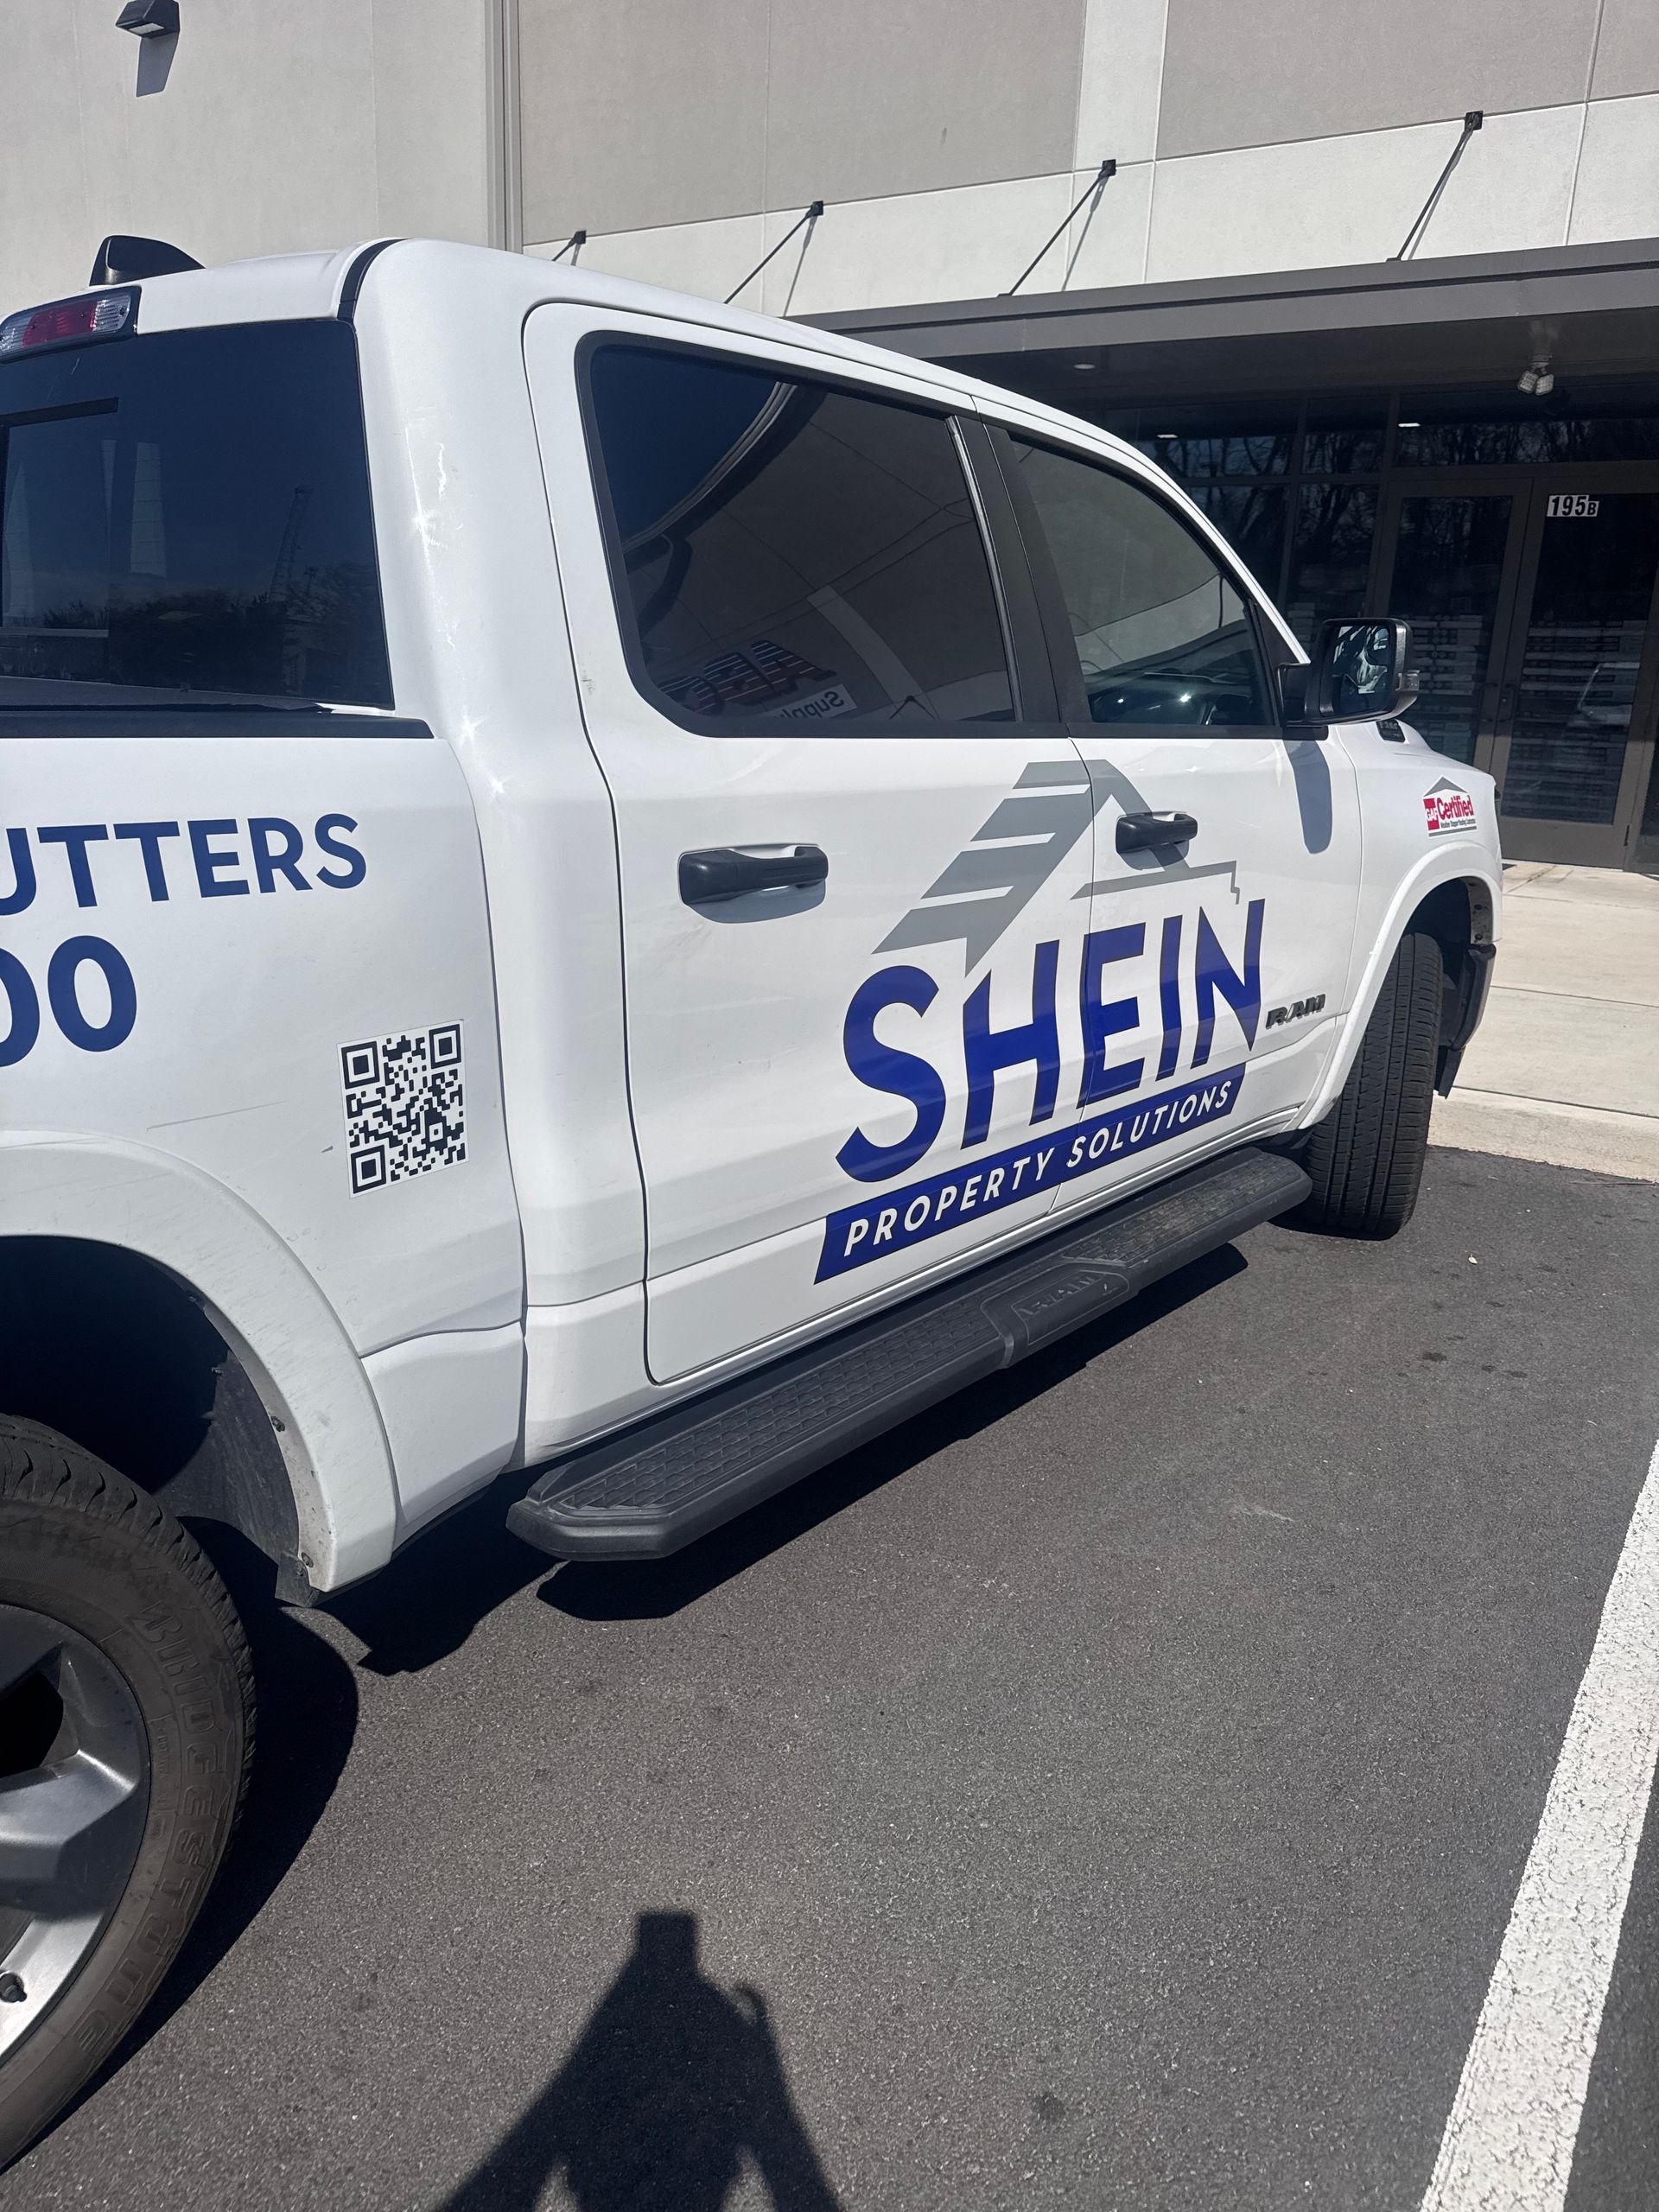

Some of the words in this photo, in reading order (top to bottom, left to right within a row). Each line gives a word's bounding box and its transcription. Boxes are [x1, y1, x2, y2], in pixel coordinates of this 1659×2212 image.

[1551, 495, 1597, 516] 195B
[1436, 794, 1474, 820] Certified
[1265, 993, 1326, 1030] RAM
[835, 898, 1265, 1183] SHEIN
[842, 1153, 1052, 1257] PROPERTY
[1065, 1080, 1233, 1168] SOLUTIONS
